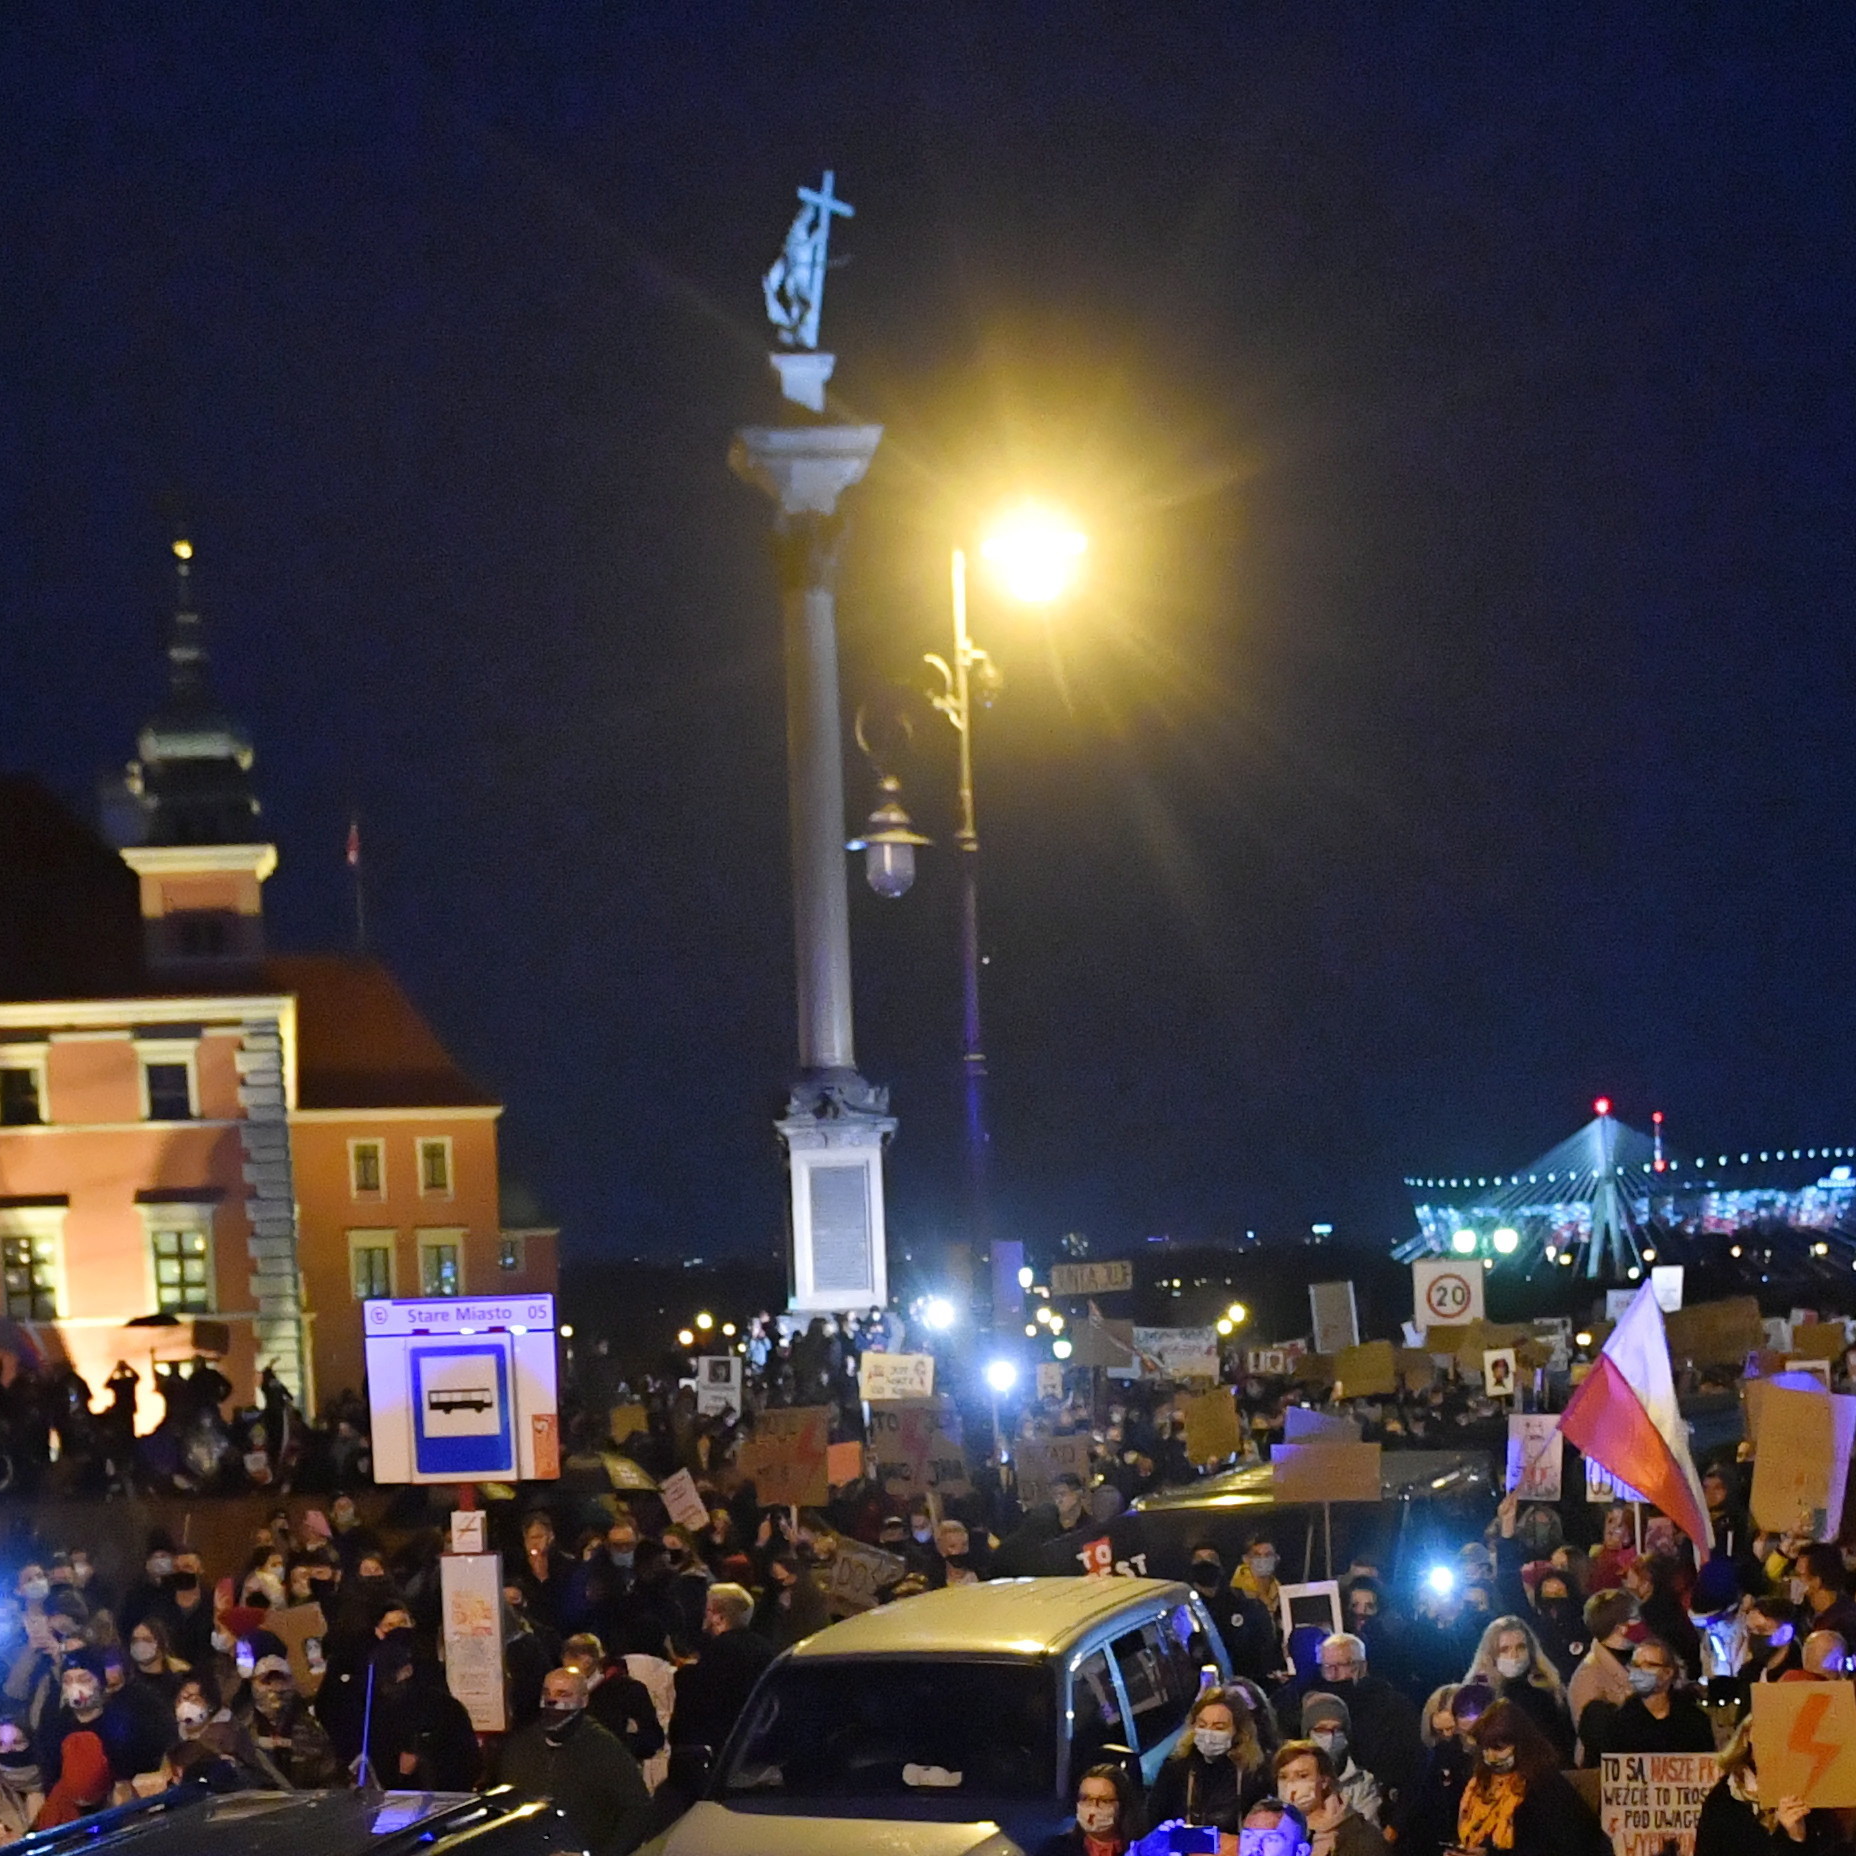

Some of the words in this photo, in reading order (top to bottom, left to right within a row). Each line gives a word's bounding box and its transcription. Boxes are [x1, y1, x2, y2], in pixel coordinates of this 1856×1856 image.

[1437, 1286, 1465, 1307] 20
[407, 1308, 450, 1324] Stare
[455, 1305, 512, 1322] Miasto
[527, 1304, 548, 1319] 05
[1602, 1757, 1620, 1782] TO
[1649, 1757, 1694, 1784] NASZE
[1654, 1787, 1672, 1806] TO
[1624, 1809, 1651, 1829] POD
